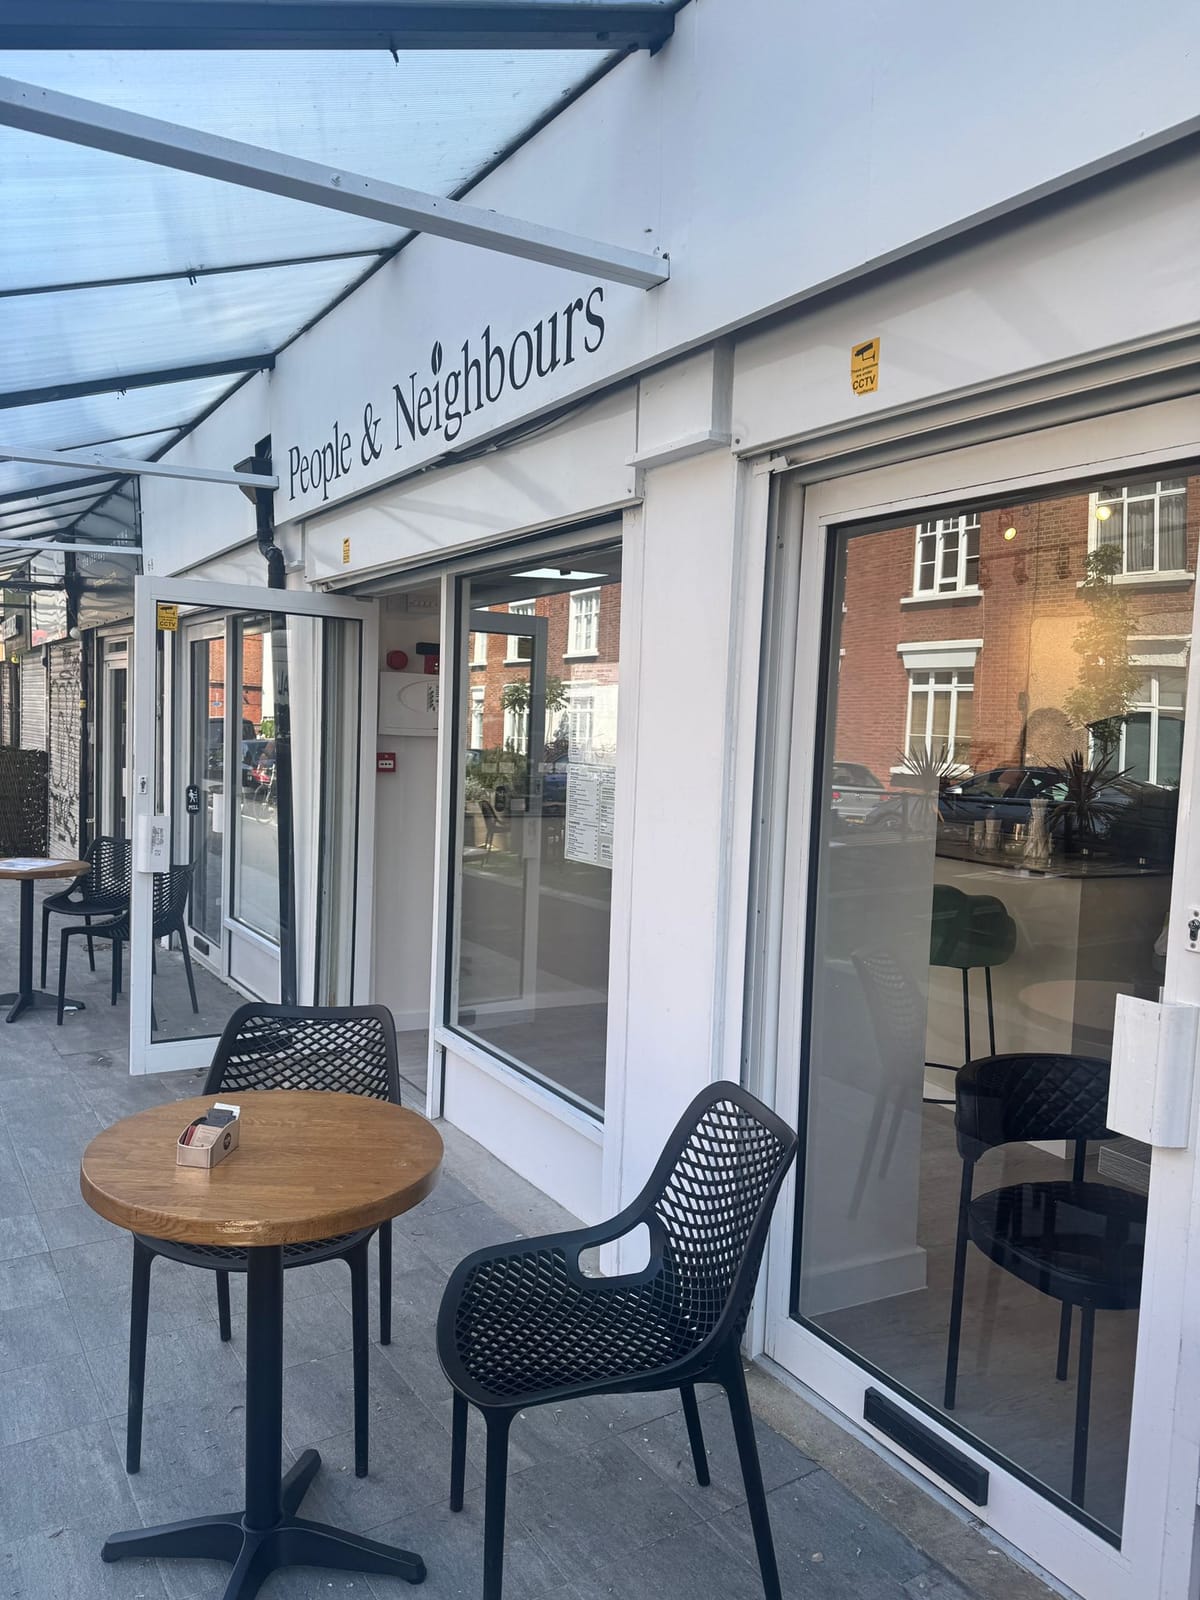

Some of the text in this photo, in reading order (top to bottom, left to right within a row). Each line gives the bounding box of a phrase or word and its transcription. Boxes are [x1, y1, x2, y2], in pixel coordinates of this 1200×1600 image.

[288, 286, 605, 501] People & Neighbours
[852, 374, 876, 391] CCTV
